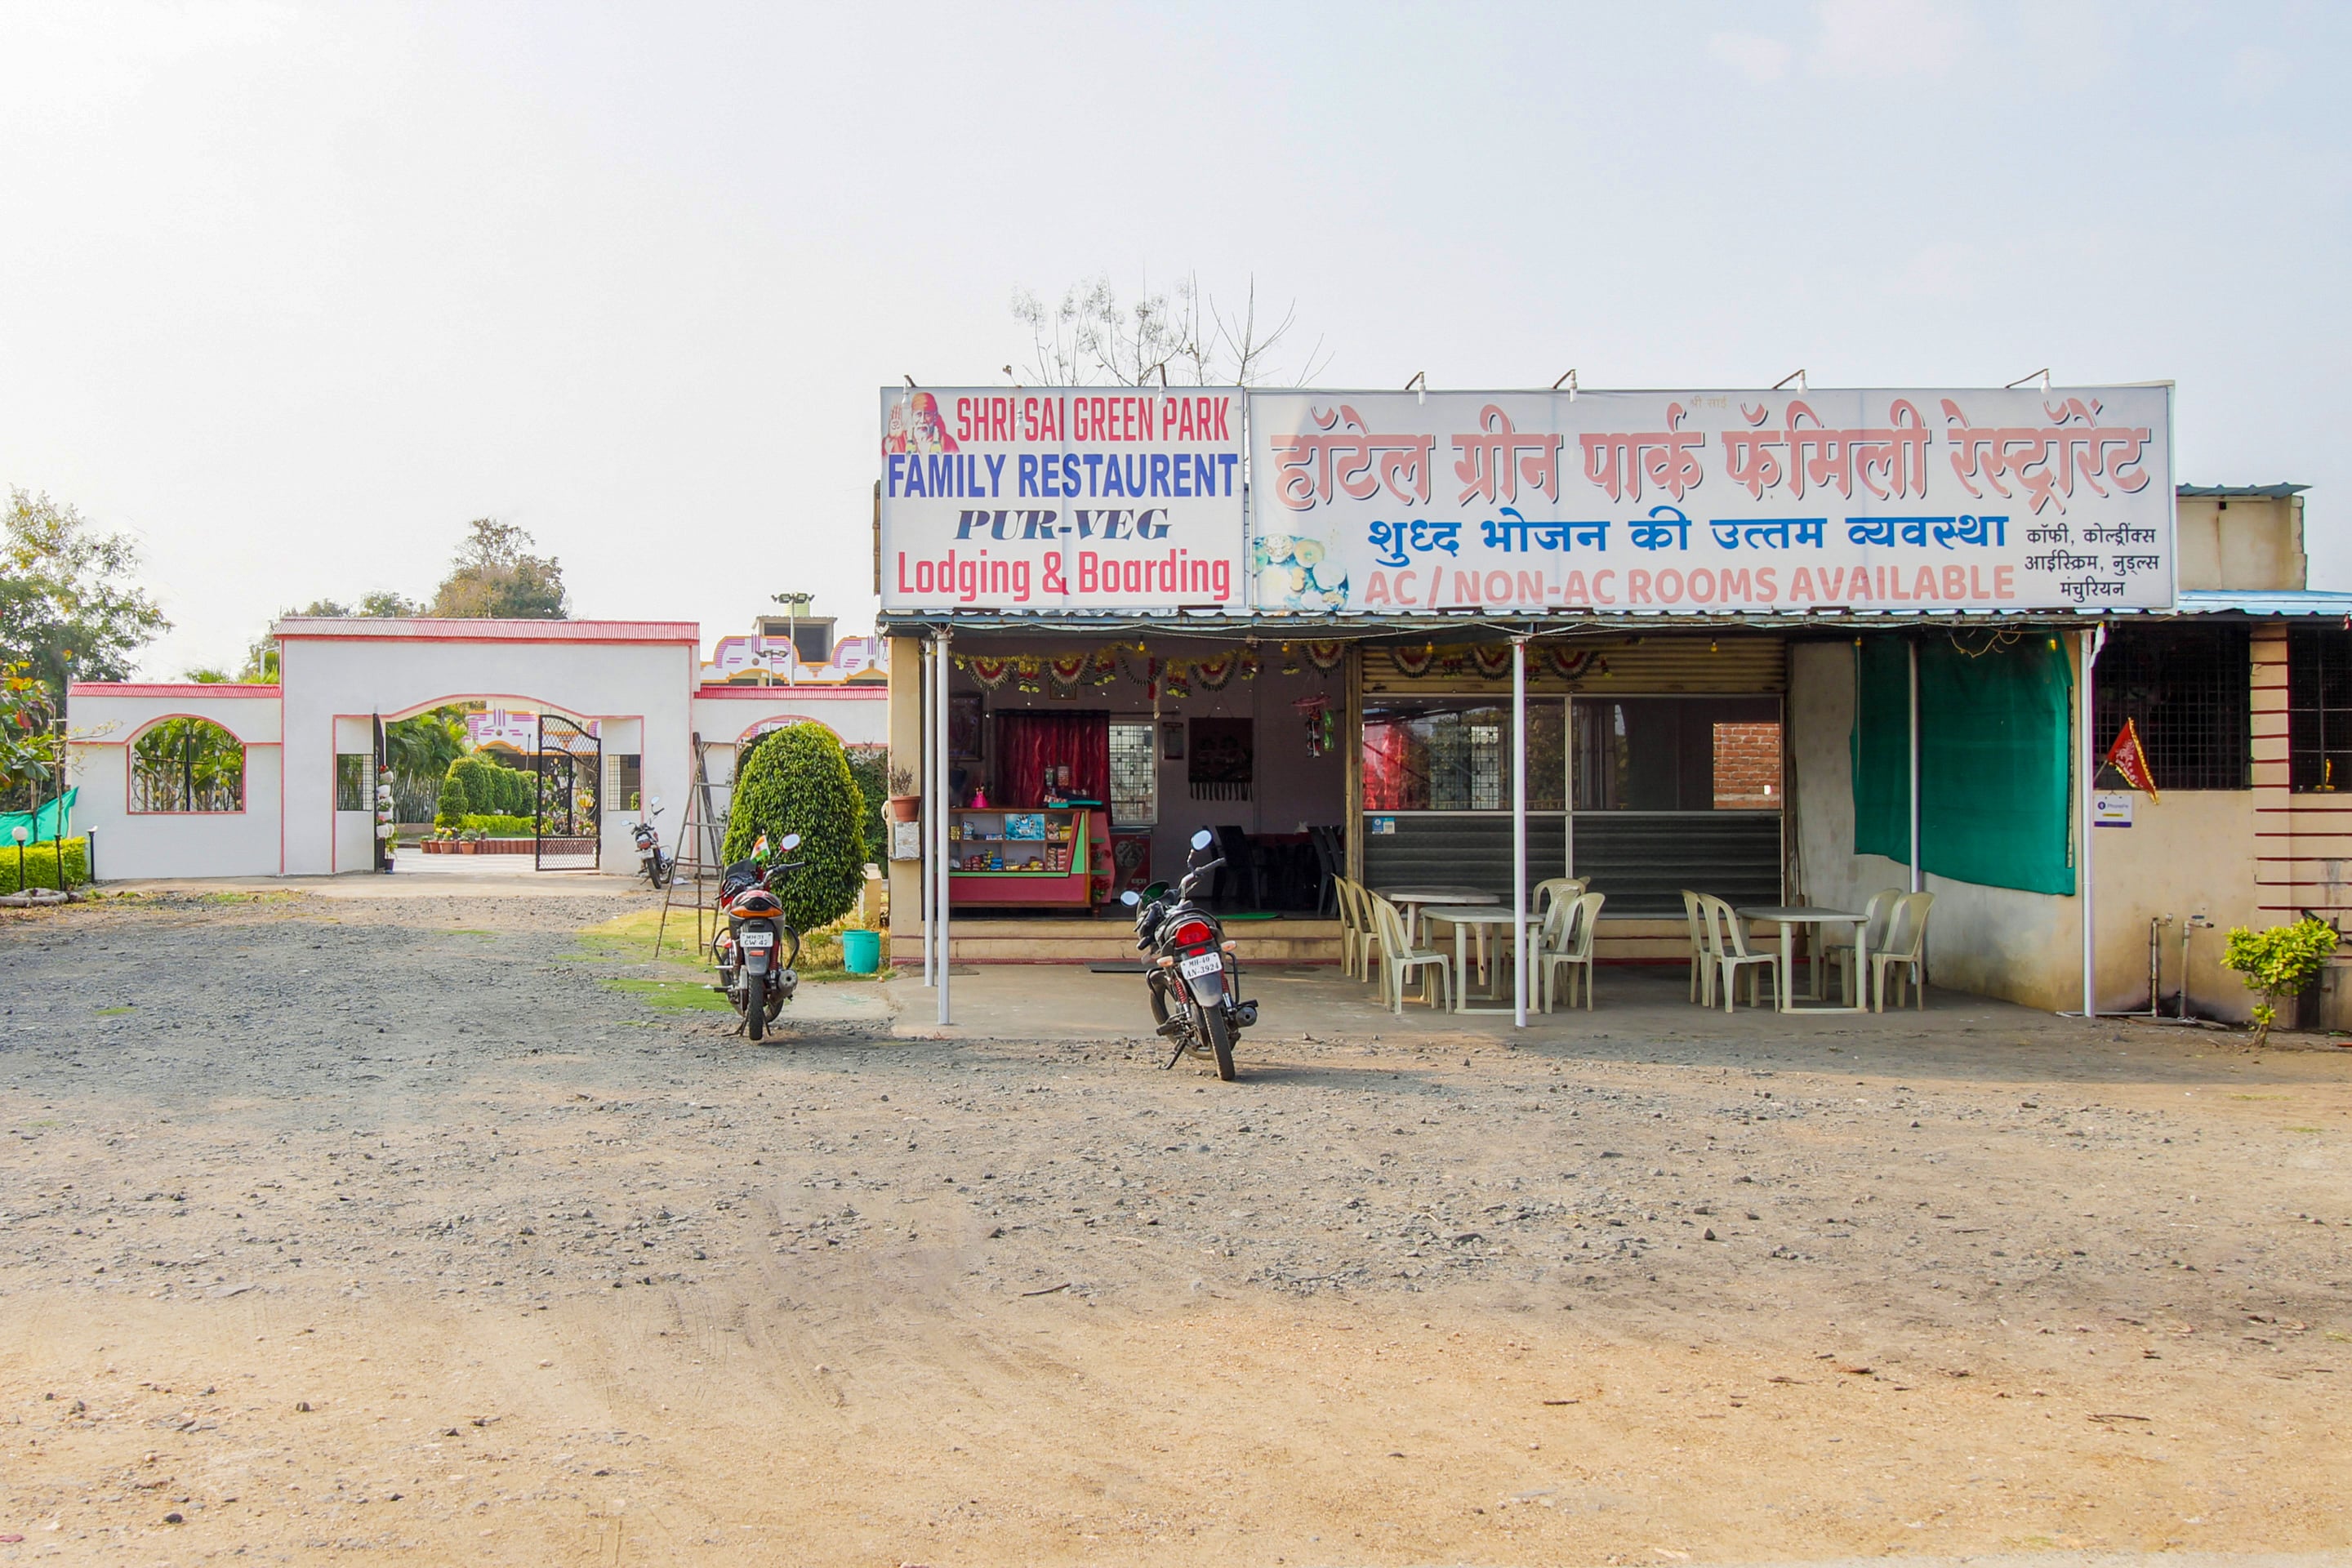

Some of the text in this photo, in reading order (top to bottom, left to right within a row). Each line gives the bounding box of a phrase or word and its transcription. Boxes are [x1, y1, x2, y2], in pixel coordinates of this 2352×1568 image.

[957, 397, 1230, 441] SHRI SAI GREEN PARK
[888, 453, 1238, 498] FAMILY RESTAURENT
[1271, 404, 1435, 511] हॉटेल
[1451, 403, 1563, 507] ग्रीन
[1579, 402, 1705, 503] पार्क
[1722, 399, 1931, 501] फॅमिली
[953, 508, 1173, 541] PUR-VEG
[1481, 507, 1610, 552] भोजन
[1628, 506, 1692, 550] की
[1710, 518, 1828, 550] उत्तम
[1845, 514, 2009, 550] व्यवस्था
[898, 549, 1230, 602] Lodging & Boarding
[1365, 570, 1418, 605] AC
[1454, 569, 1616, 604] NON-AC
[1628, 567, 1779, 604] ROOMS
[1789, 564, 2016, 602] AVAILABLE
[2060, 576, 2125, 603] मंचुरियन
